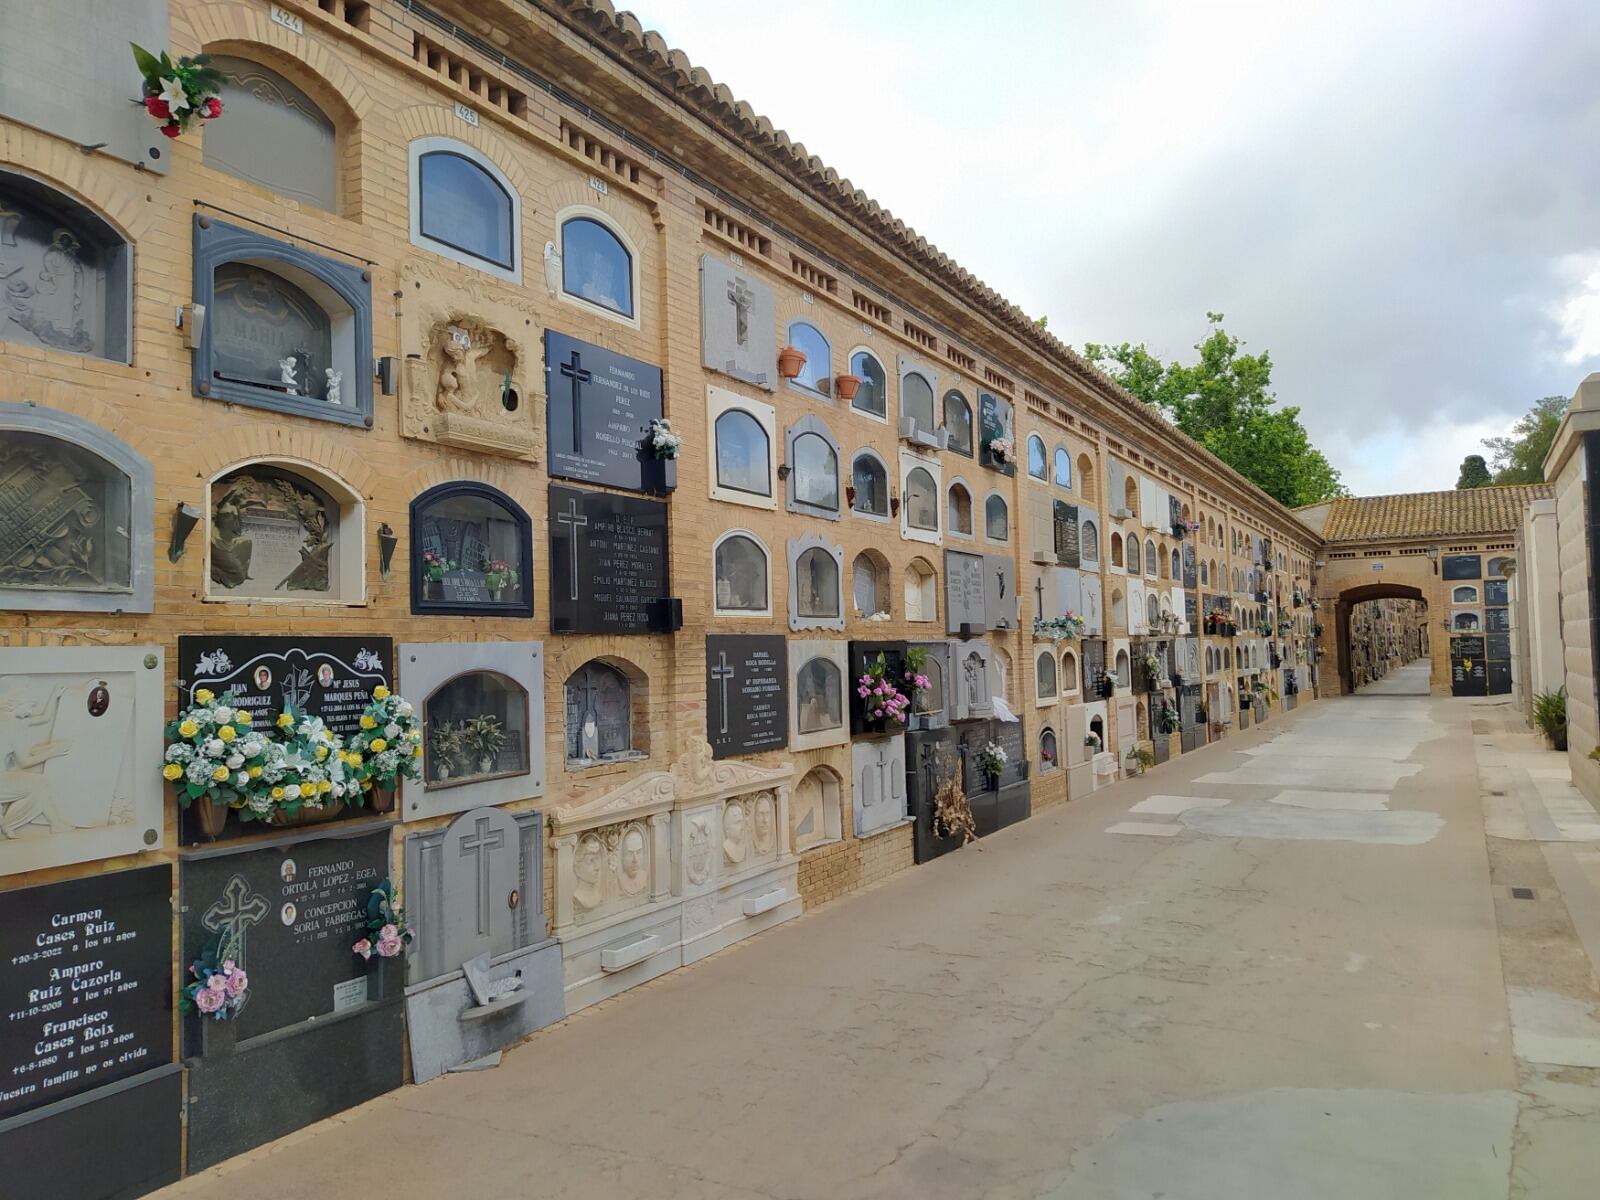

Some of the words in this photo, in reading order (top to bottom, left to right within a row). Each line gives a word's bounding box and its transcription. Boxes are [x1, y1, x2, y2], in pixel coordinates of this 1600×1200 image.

[276, 8, 300, 31] 424
[459, 105, 476, 123] 425
[230, 683, 248, 695] JUAN
[342, 679, 360, 689] JESUS
[232, 696, 272, 707] RODRIGUEZ
[324, 692, 353, 704] MARQUES
[353, 690, 369, 701] PEÑA
[308, 860, 354, 878] FERNANDO
[281, 880, 318, 896] ORTOLA
[323, 873, 350, 888] LOPEZ
[356, 868, 377, 880] EGEA
[51, 908, 103, 928] Carmen
[304, 898, 358, 919] CONCEPCION
[293, 920, 320, 935] SORIA
[325, 909, 367, 928] FABREGAS
[36, 929, 76, 947] Cases
[85, 920, 116, 937] Ruiz
[72, 943, 79, 952] a
[85, 939, 99, 949] los
[116, 930, 137, 943] años
[49, 960, 104, 982] Amparo
[28, 985, 62, 1004] Ruiz
[71, 969, 122, 992] Cazorla
[72, 996, 79, 1004] a
[85, 991, 100, 1001] los
[103, 986, 113, 996] 97
[117, 980, 138, 993] años
[42, 1010, 109, 1037] Francisco
[34, 1036, 75, 1056] Cases
[83, 1023, 115, 1041] Boix
[67, 1051, 74, 1059] a
[80, 1044, 95, 1055] los
[113, 1031, 135, 1045] años
[43, 1069, 79, 1088] familia
[85, 1064, 98, 1075] no
[102, 1058, 114, 1068] os
[119, 1047, 148, 1063] olvida
